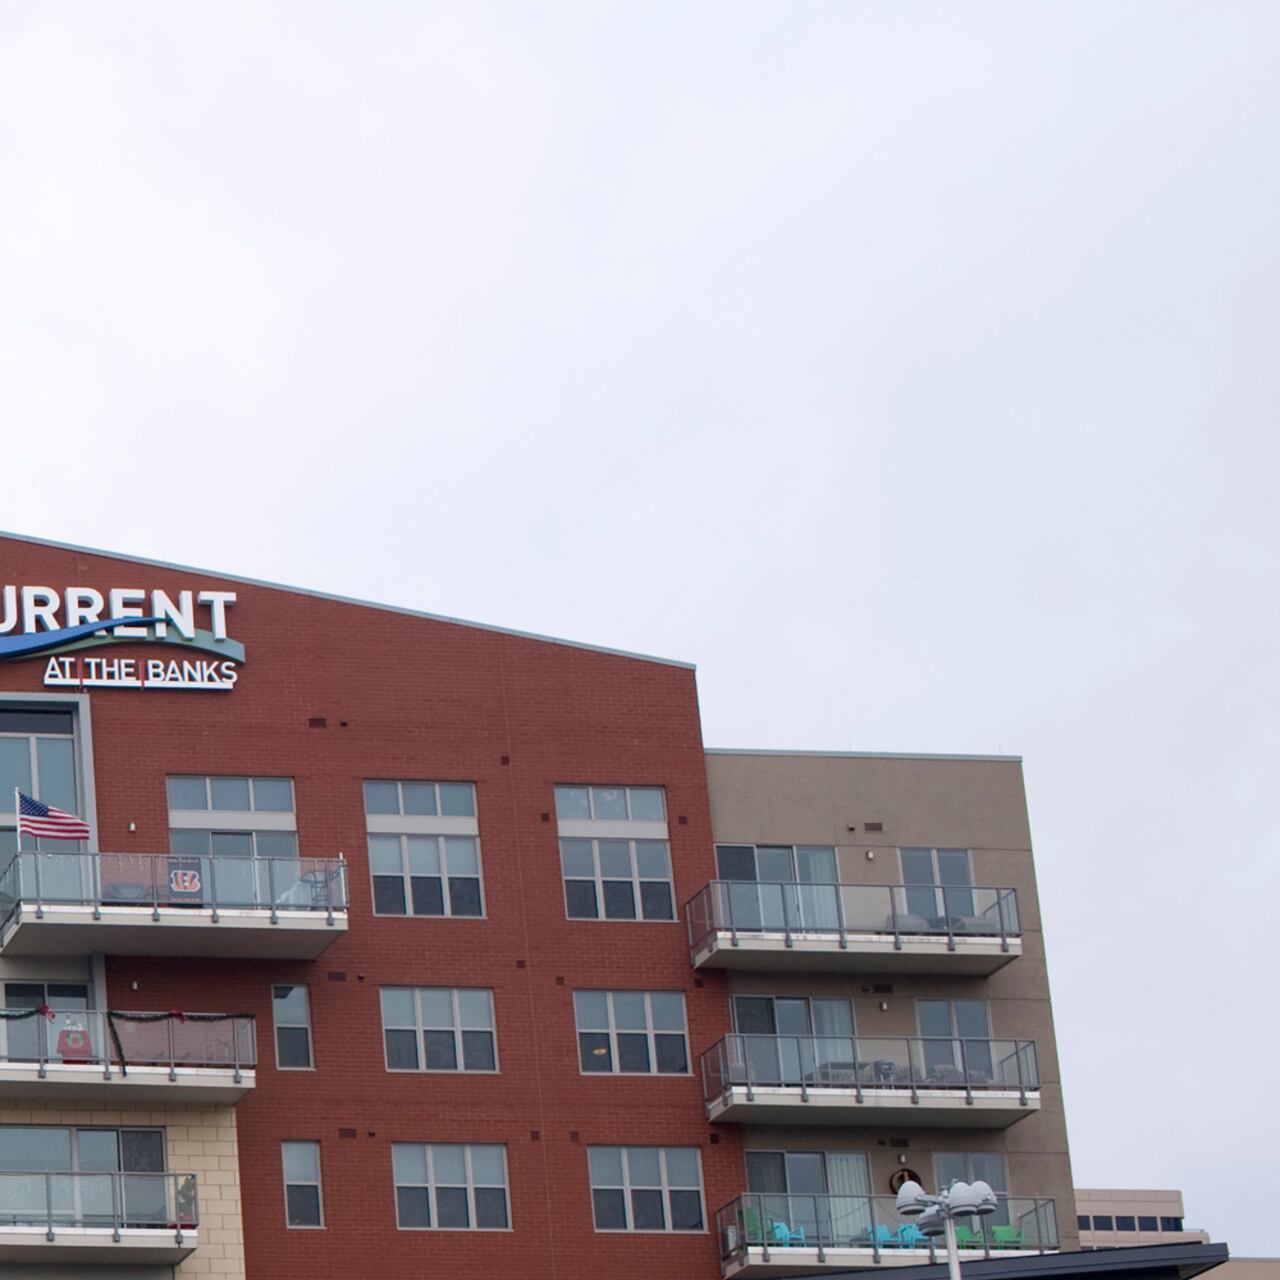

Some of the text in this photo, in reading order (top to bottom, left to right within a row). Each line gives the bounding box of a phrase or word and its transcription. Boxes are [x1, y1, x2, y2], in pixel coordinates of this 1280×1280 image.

[44, 657, 238, 683] AT THE BANKS
